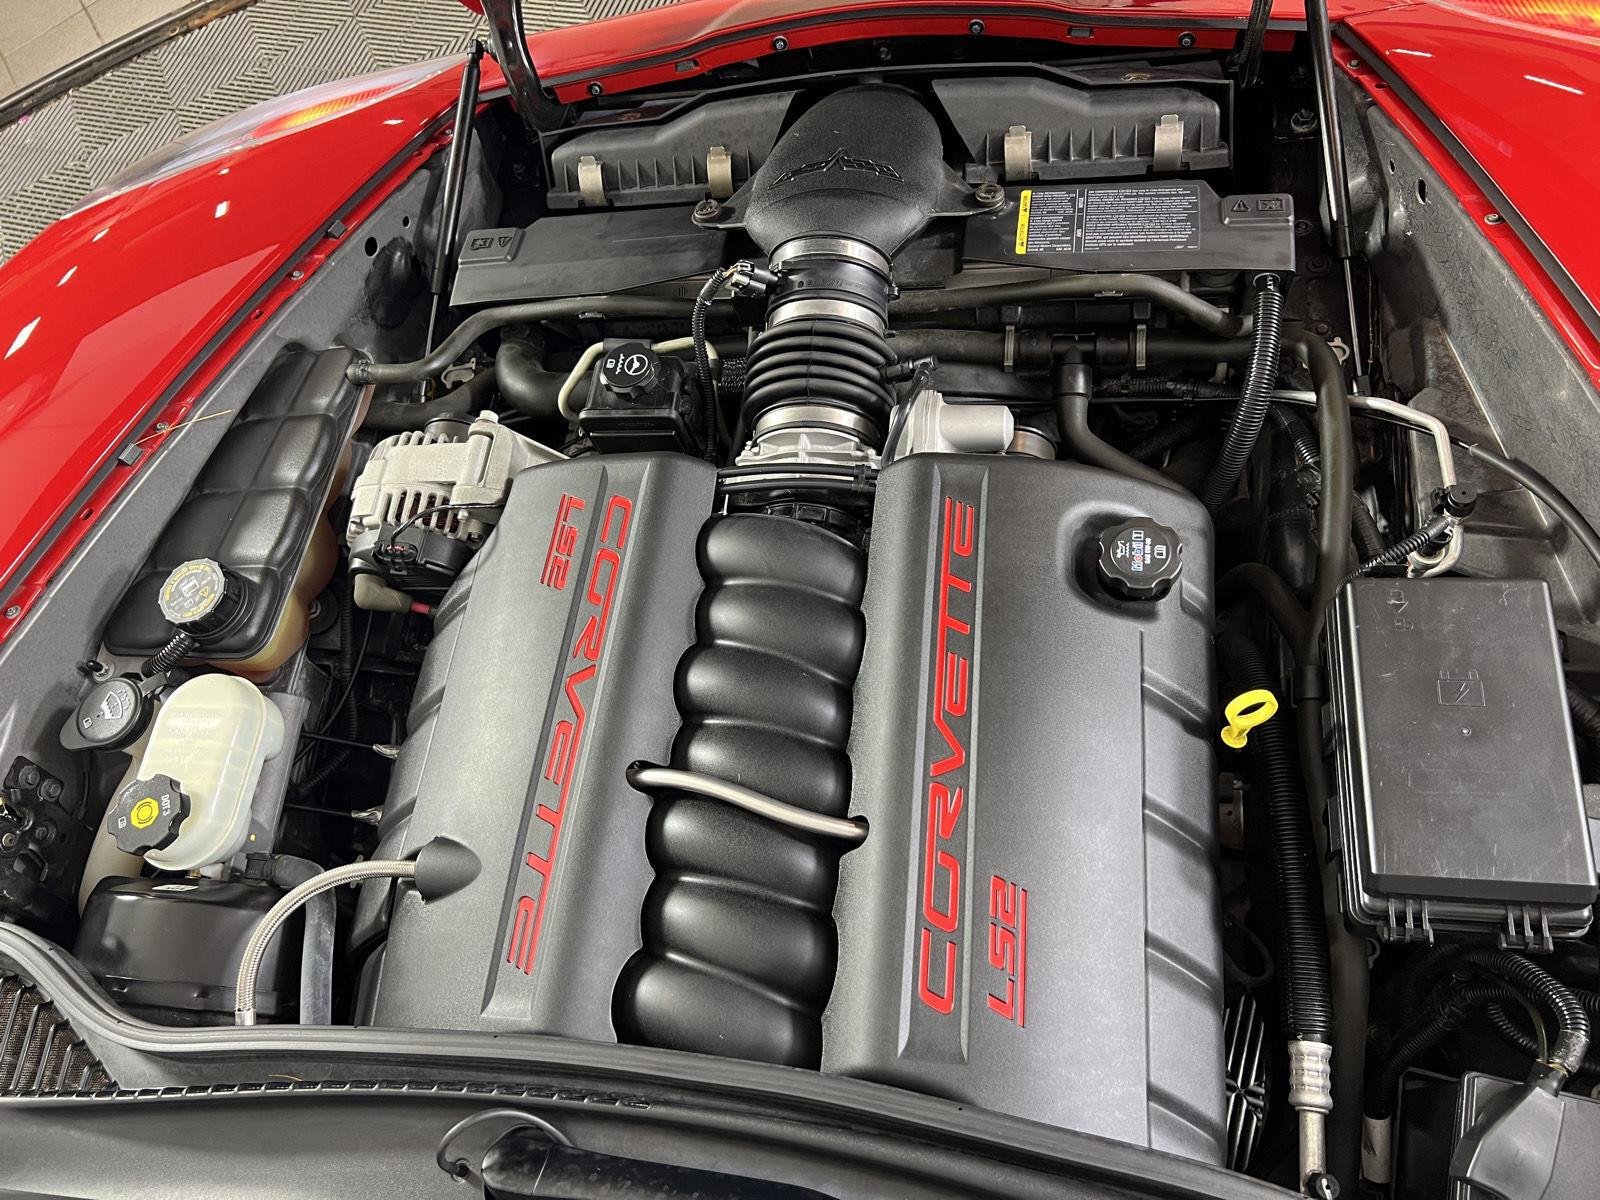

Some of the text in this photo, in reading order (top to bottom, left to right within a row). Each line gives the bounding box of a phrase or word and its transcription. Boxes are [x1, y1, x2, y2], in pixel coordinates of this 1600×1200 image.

[544, 492, 586, 591] LS2
[1131, 541, 1144, 571] Mobil
[507, 494, 632, 977] CORVETTE
[918, 495, 975, 1016] CORVETTE
[161, 793, 170, 807] DOT
[986, 874, 1016, 1021] LS2
